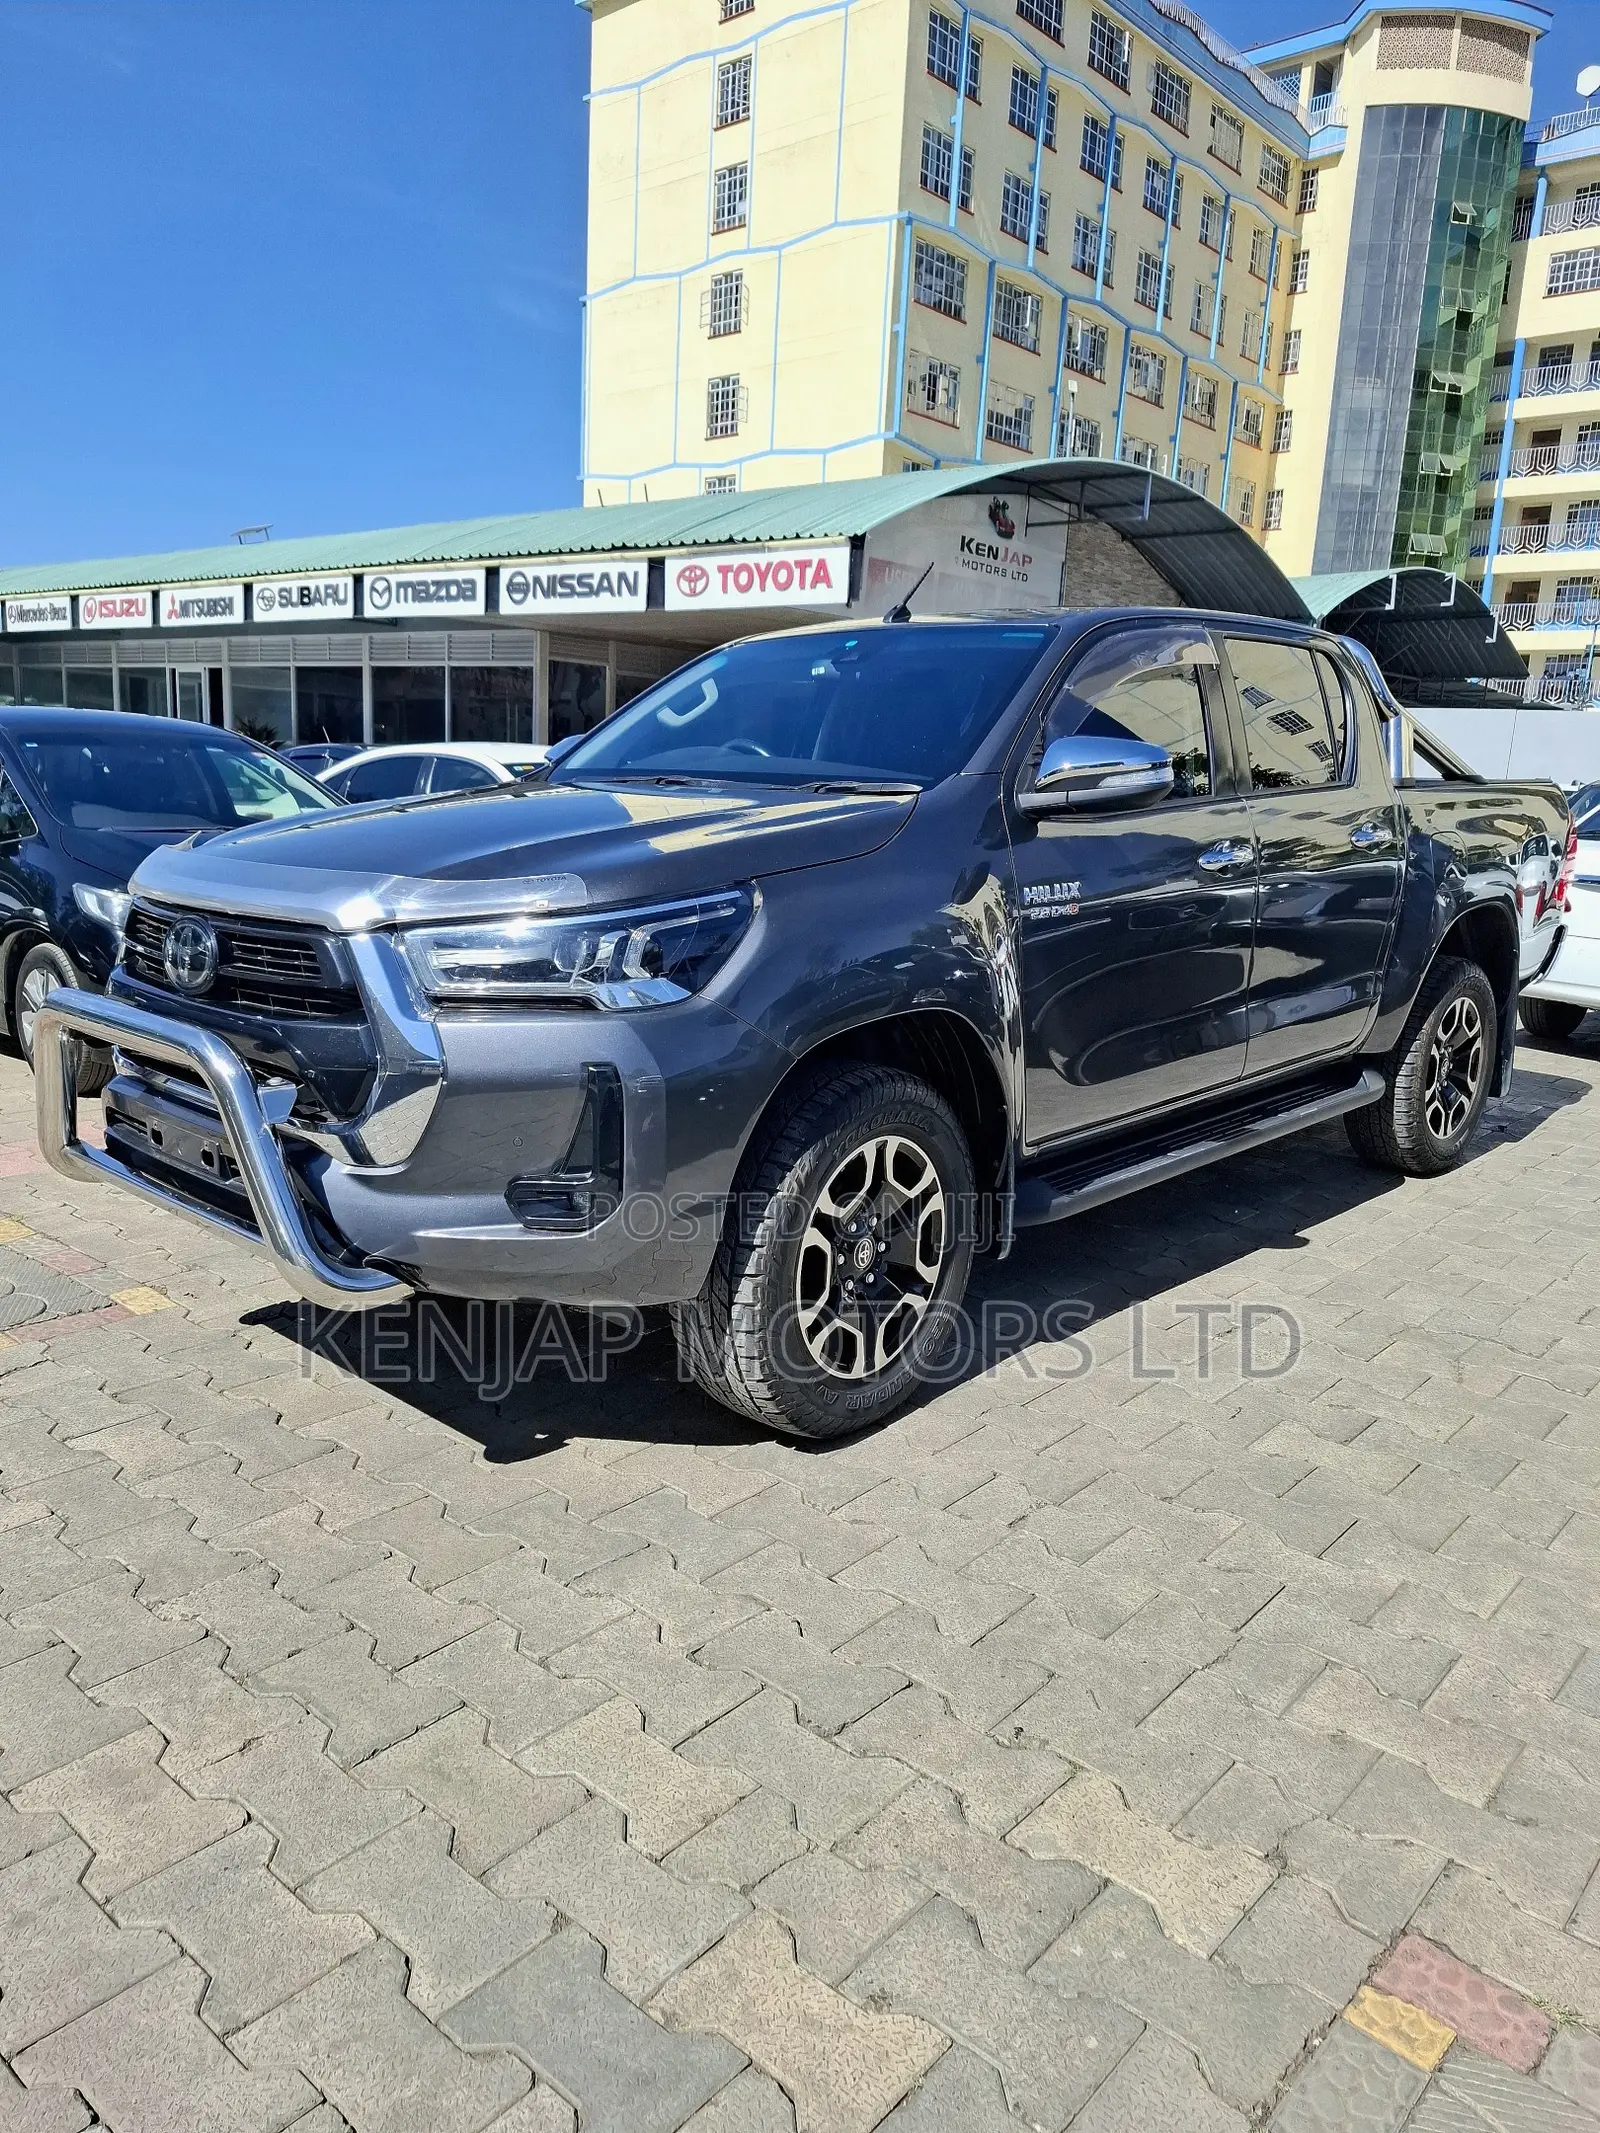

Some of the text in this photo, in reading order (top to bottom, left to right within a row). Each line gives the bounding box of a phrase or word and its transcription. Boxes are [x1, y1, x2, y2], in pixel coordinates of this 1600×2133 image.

[717, 558, 834, 595] TOYOTA
[961, 558, 1029, 582] MOTORS LTD
[278, 582, 348, 608] SUBARU
[532, 571, 639, 600] NISSAN
[16, 602, 68, 623] Mercedes-Benz
[98, 598, 147, 618] ISUZU
[179, 596, 235, 619] MITSUBISHI
[1023, 881, 1082, 905] HILUX
[832, 1110, 930, 1160] YOKOHAMA
